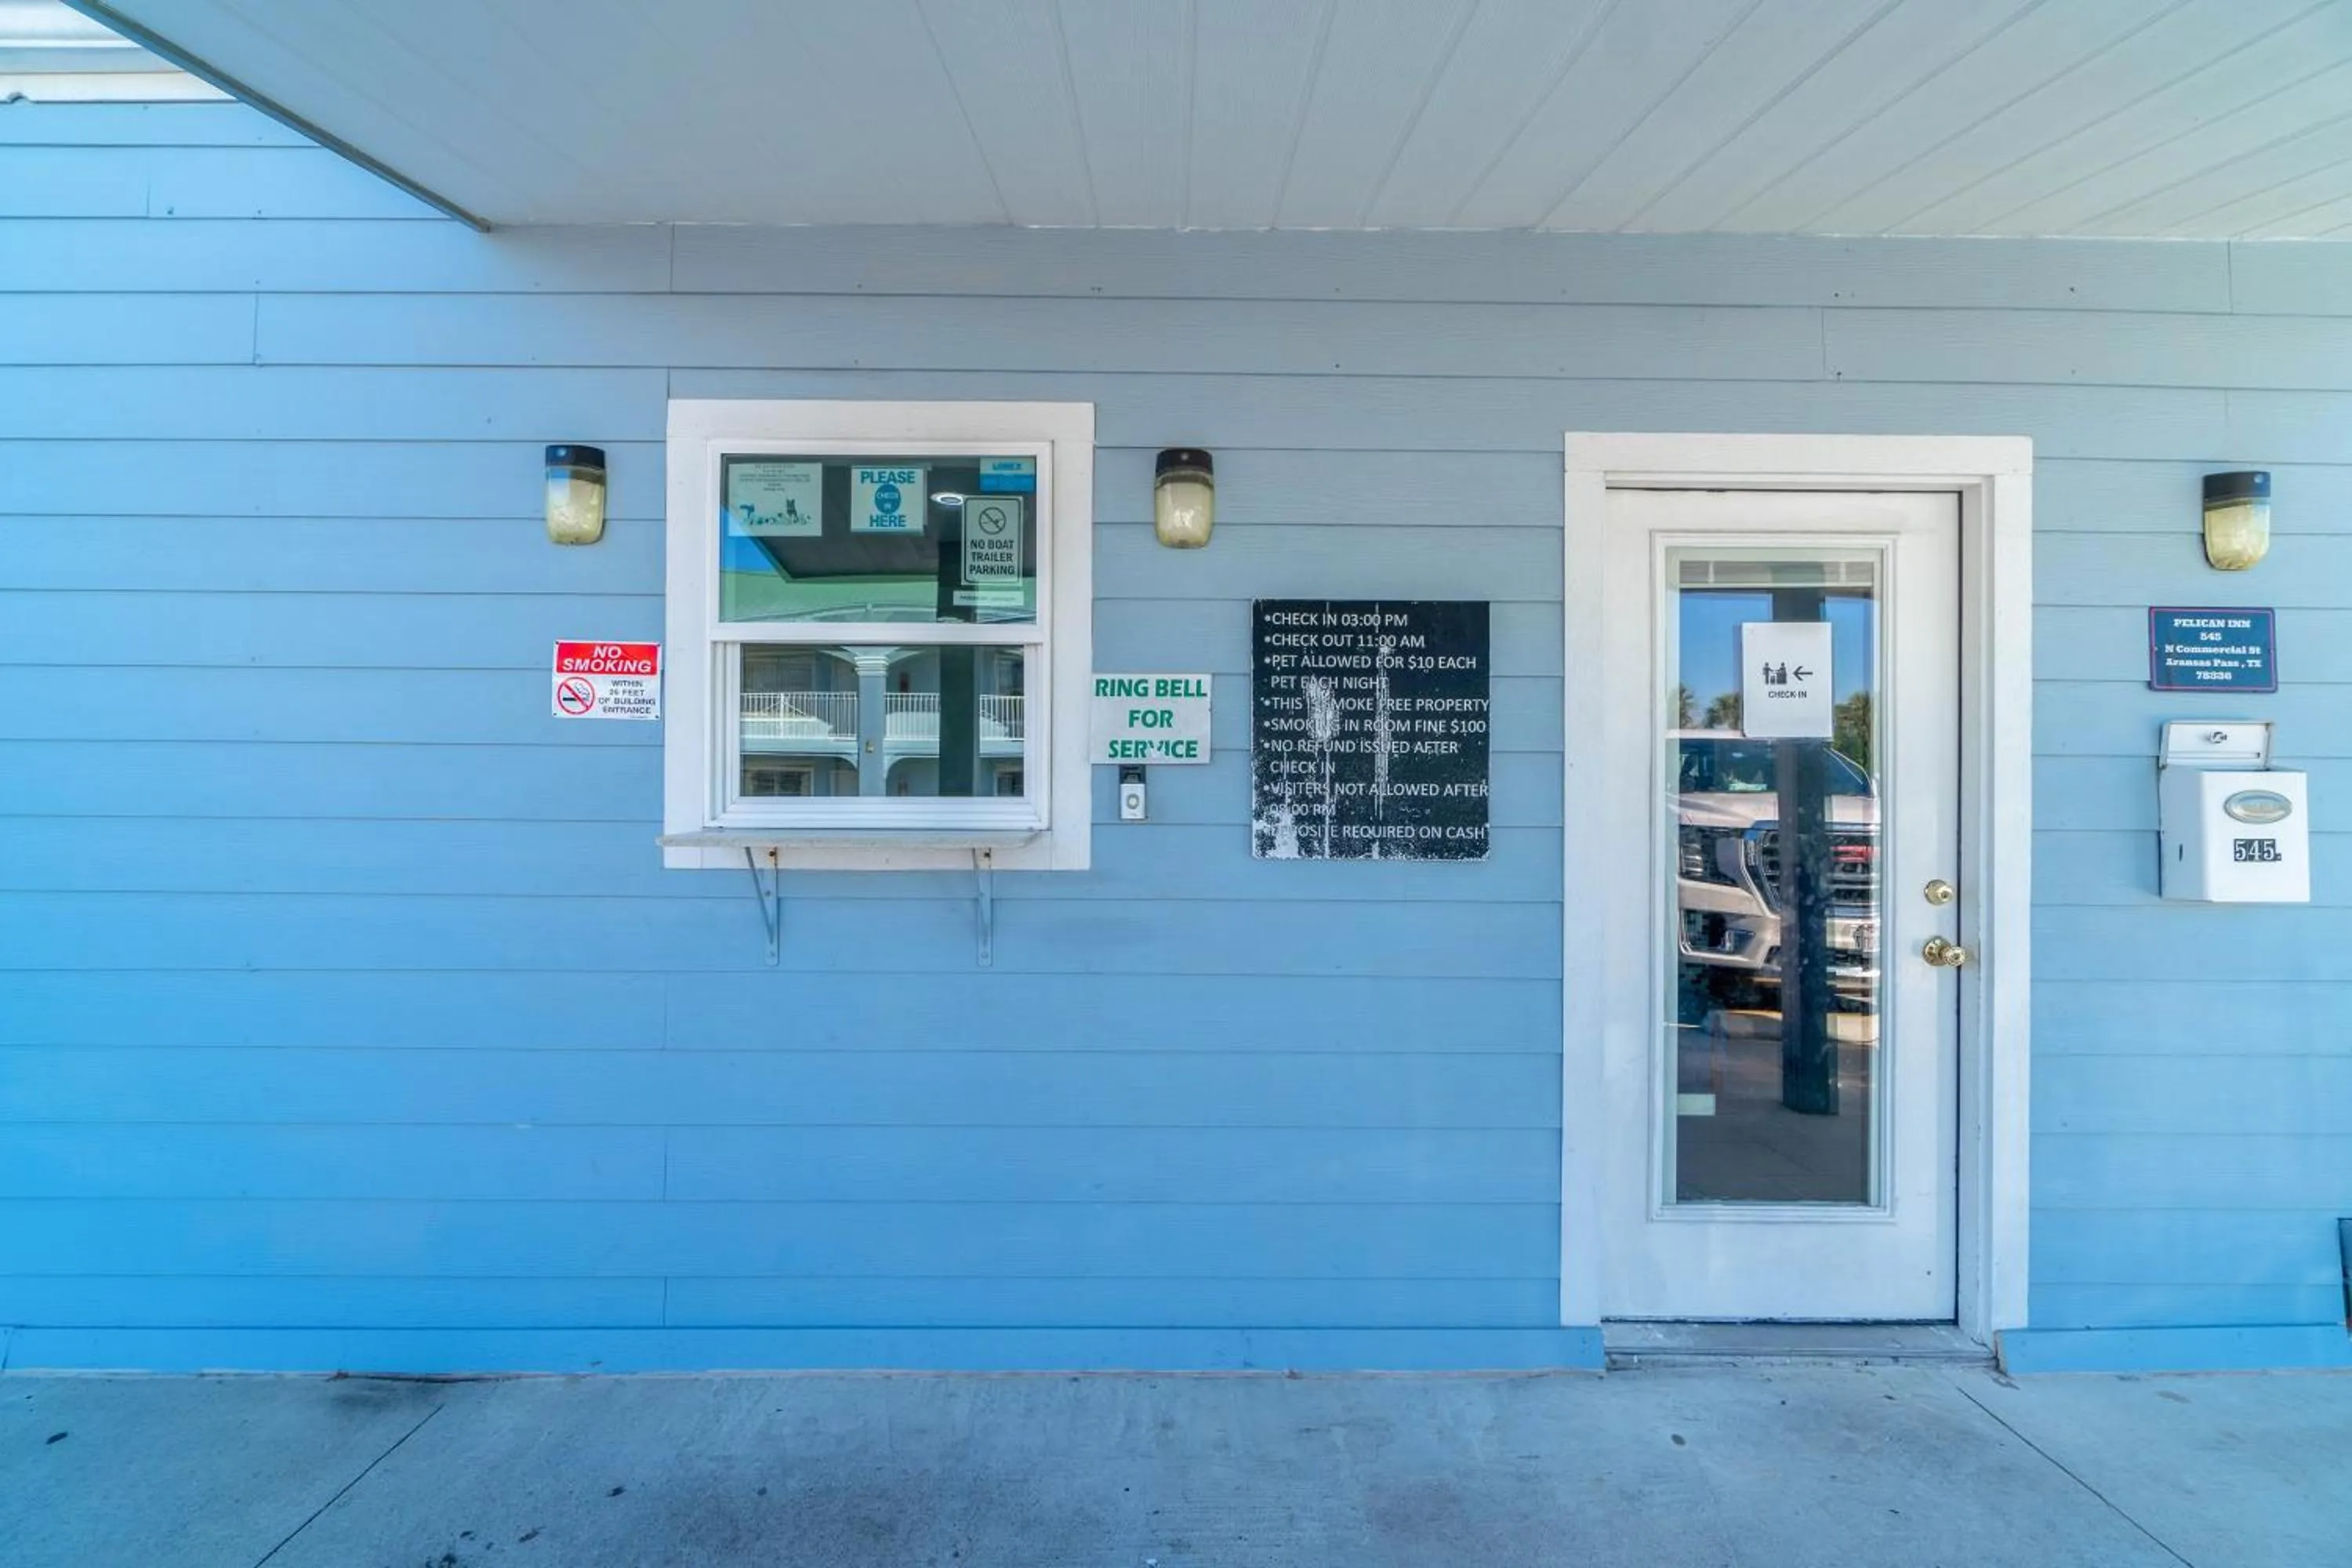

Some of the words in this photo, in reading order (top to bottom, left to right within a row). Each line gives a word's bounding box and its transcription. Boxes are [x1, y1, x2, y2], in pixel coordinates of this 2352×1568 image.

[860, 470, 916, 484] PLEASE
[869, 514, 907, 528] HERE
[970, 539, 985, 550] NO
[987, 539, 1014, 550] BOAT
[971, 552, 1013, 562] TRAILER
[969, 564, 1015, 575] PARKING
[1272, 612, 1318, 626] CHECK
[1323, 614, 1337, 626] IN
[1341, 614, 1381, 626] 03:00
[1385, 614, 1408, 626] PM
[2173, 619, 2225, 628] PELICAN
[2228, 619, 2251, 628] INN
[1272, 633, 1318, 647] CHECK
[1322, 634, 1354, 647] OUT
[1357, 634, 1396, 647] 11:00
[1399, 635, 1425, 648] AM
[2200, 632, 2222, 641] 545
[593, 645, 622, 659] NO
[2165, 644, 2174, 653] N
[2176, 644, 2246, 655] Commercial
[2249, 645, 2261, 655] St
[562, 658, 652, 673] SMOKING
[1272, 655, 1298, 667] PET
[1301, 655, 1371, 668] ALLOWED
[1376, 656, 1404, 668] FOR
[1407, 655, 1434, 670] $10
[1439, 656, 1476, 669] EACH
[2165, 658, 2211, 666] Aransas
[2246, 659, 2263, 668] TX
[1094, 678, 1149, 697] RING
[1155, 679, 1207, 697] BELL
[1271, 675, 1297, 688] PET
[1301, 676, 1338, 689] EACH
[1343, 677, 1388, 689] NIGHT
[614, 697, 656, 706] BUILDING
[1272, 697, 1303, 710] THIS
[1416, 699, 1489, 711] PROPERTY
[1128, 710, 1174, 728] FOR
[1345, 719, 1359, 731] IN
[1363, 719, 1410, 732] ROOM
[1415, 720, 1446, 732] FINE
[1451, 719, 1486, 734] $100
[1108, 739, 1199, 759] SERVICE
[1271, 739, 1294, 752] NO
[1298, 739, 1356, 753] REFUND
[1360, 740, 1410, 753] ISSUED
[1414, 741, 1458, 753] AFTER
[1269, 761, 1316, 774] CHECK
[1321, 762, 1336, 774] IN
[1271, 782, 1330, 795] VISITERS
[1336, 783, 1366, 796] NOT
[1369, 783, 1439, 796] ALLOWED
[1443, 784, 1489, 797] AFTER
[1269, 825, 1338, 838] OSITE
[1343, 826, 1415, 839] REQUIRED
[1419, 826, 1442, 838] ON
[1446, 826, 1484, 840] CASH
